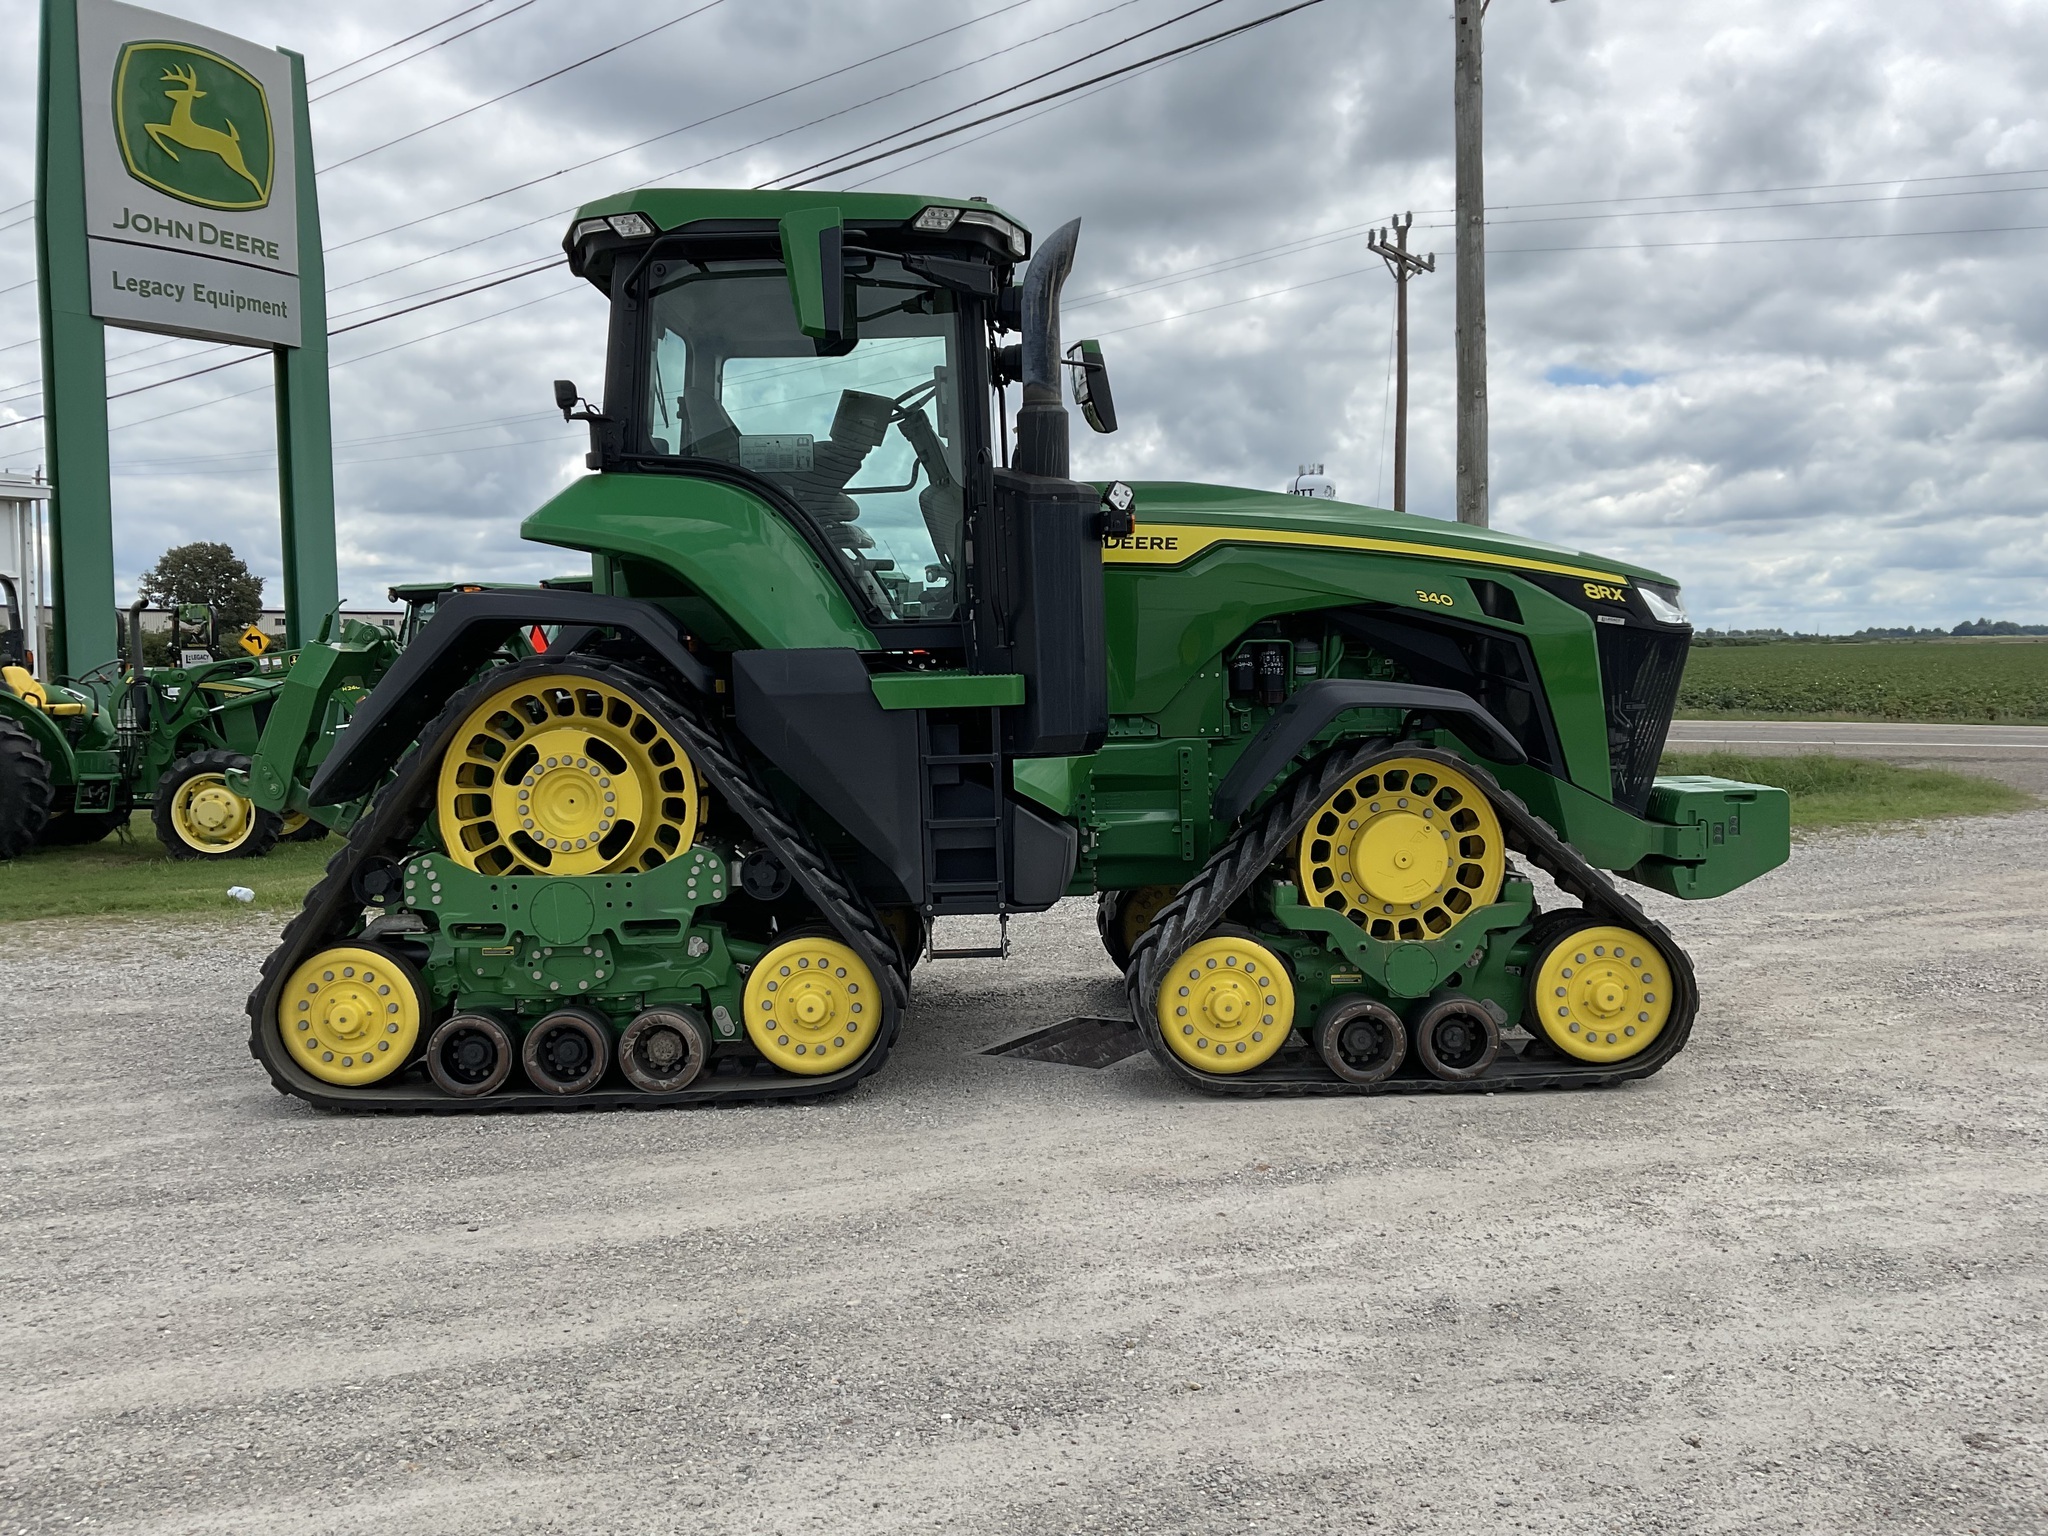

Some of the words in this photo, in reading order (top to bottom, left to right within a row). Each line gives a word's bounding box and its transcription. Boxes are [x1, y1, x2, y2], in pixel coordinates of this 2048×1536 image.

[113, 207, 193, 241] JOHN
[199, 221, 280, 260] DEERE
[112, 270, 185, 302] Legacy
[193, 283, 287, 318] Equipment
[1104, 535, 1178, 550] DEERE
[1415, 590, 1454, 607] 340
[1583, 583, 1626, 602] 8RX
